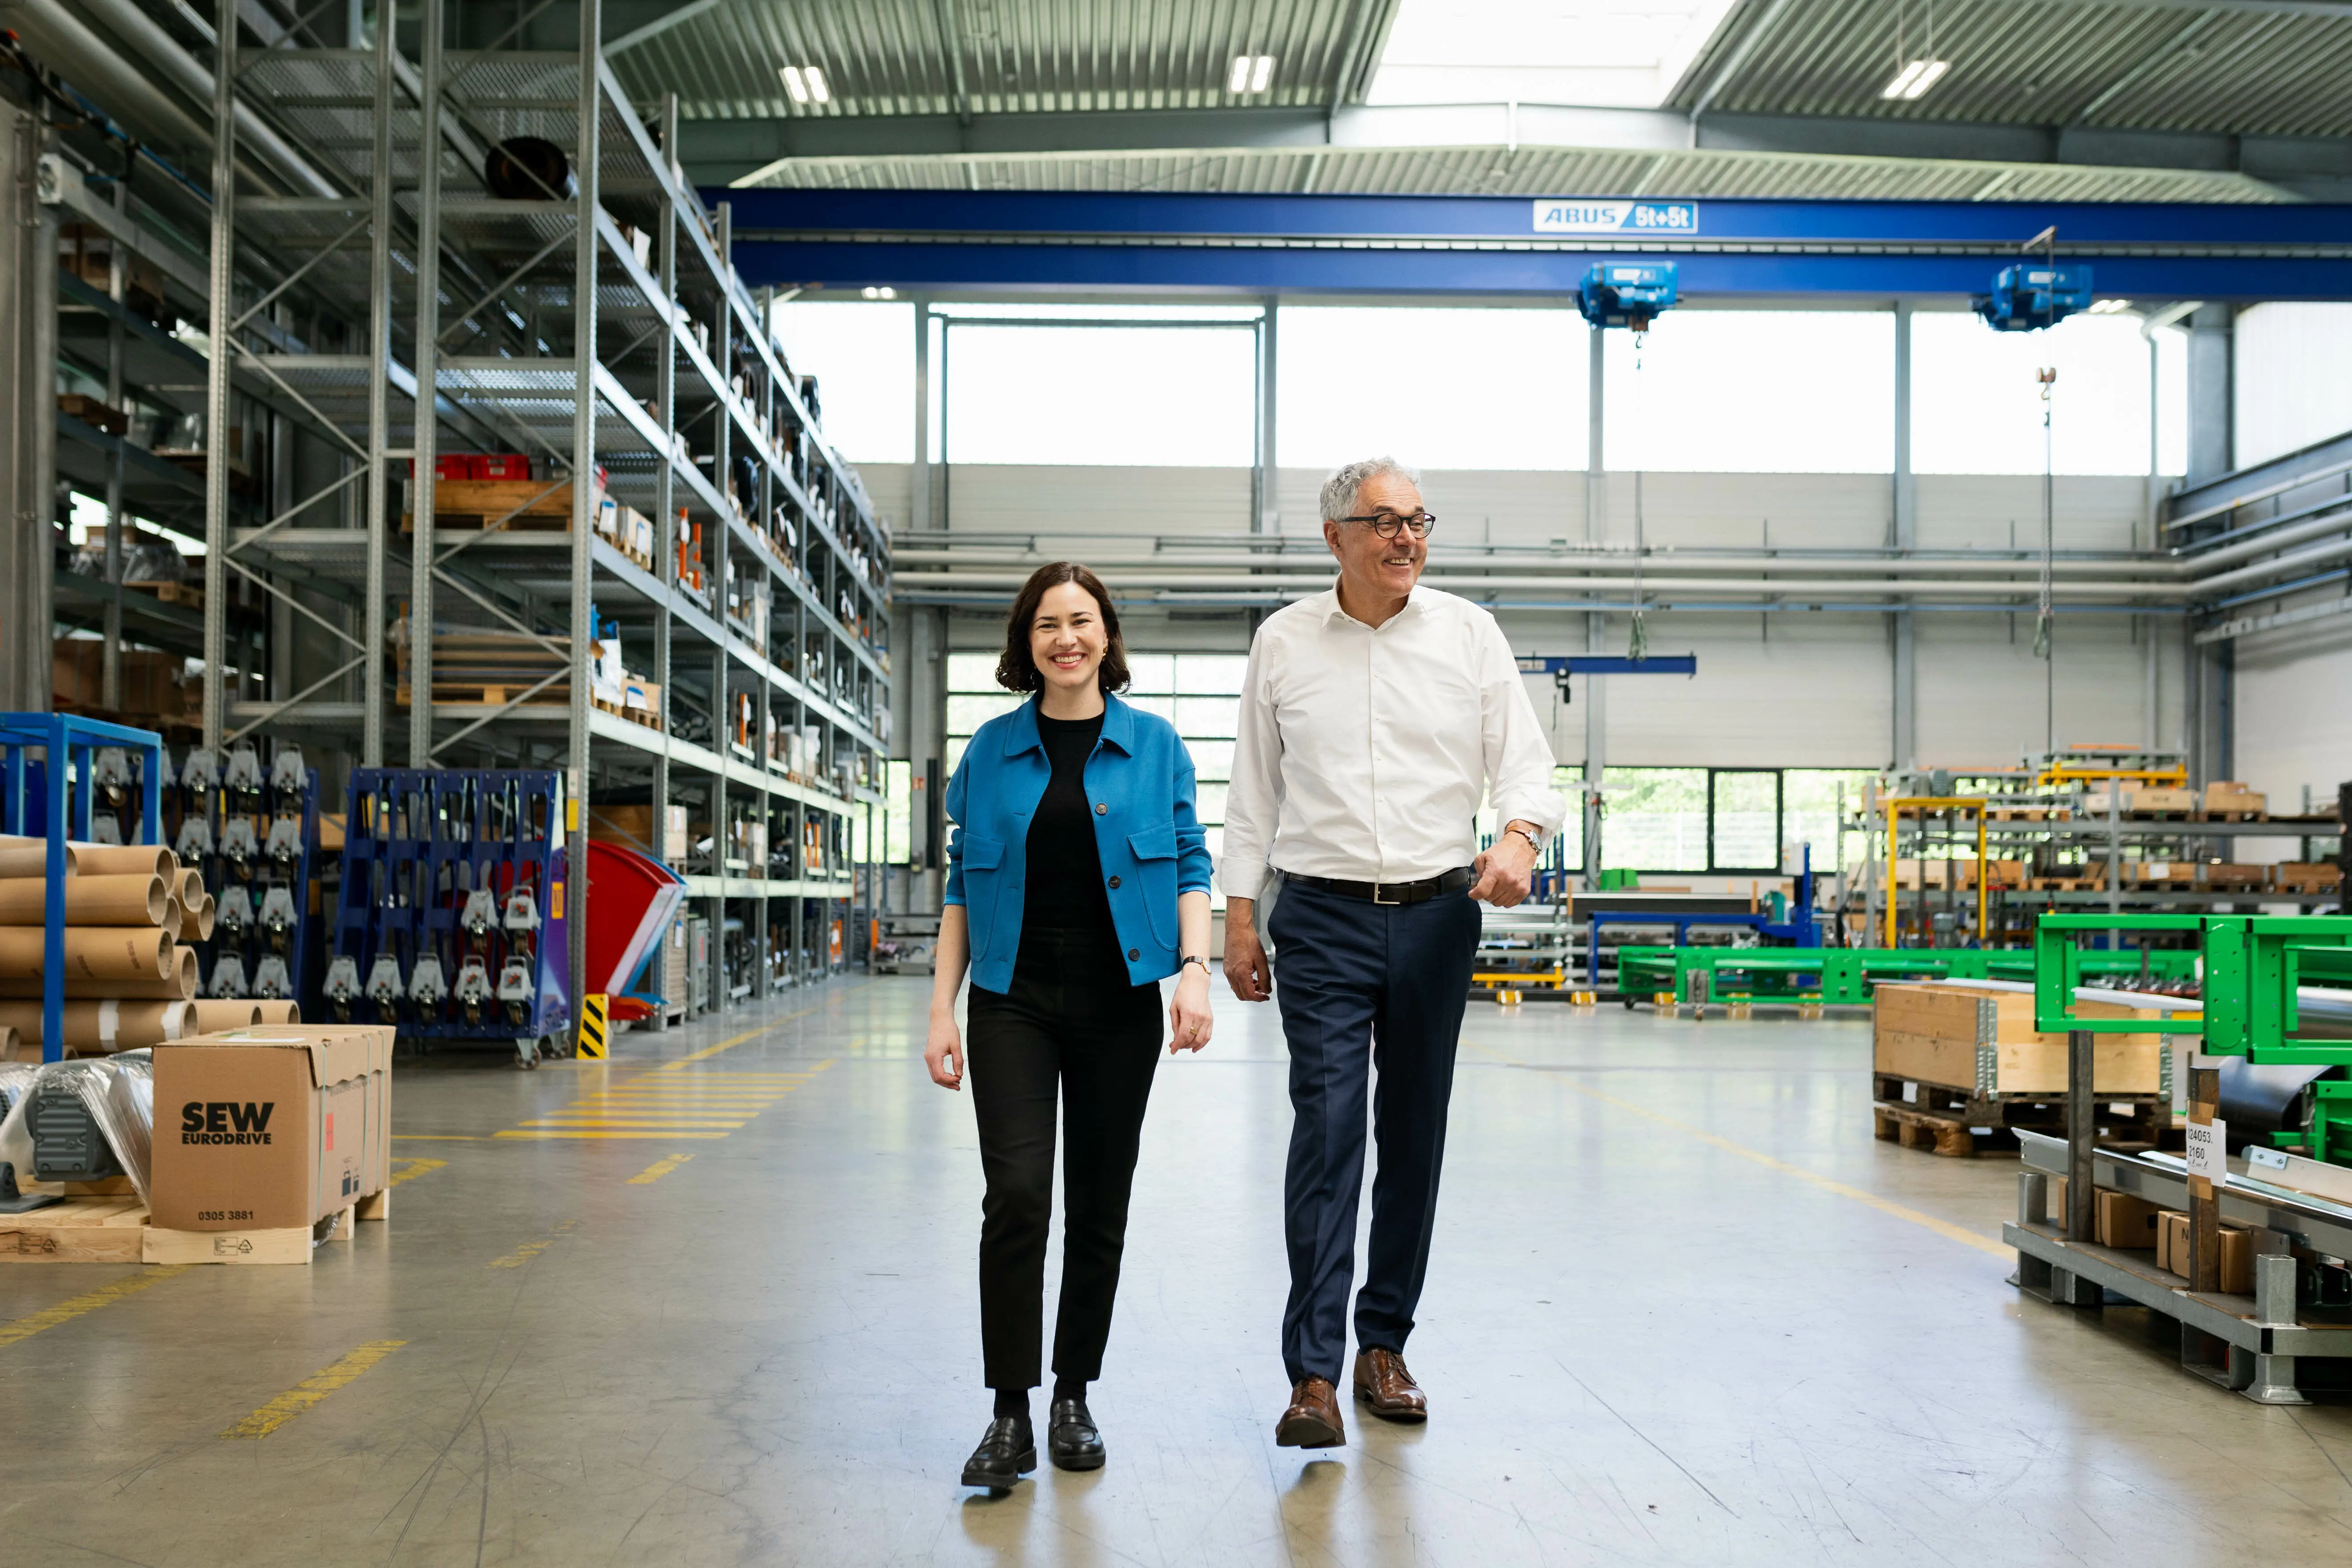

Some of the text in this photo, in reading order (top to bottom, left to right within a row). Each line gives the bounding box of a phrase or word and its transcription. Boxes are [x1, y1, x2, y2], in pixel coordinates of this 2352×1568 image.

[1544, 206, 1690, 227] ABUS 5t+5t
[181, 1101, 274, 1133] SEW
[182, 1133, 271, 1145] EURODRIVE
[2189, 1145, 2205, 1159] 2160
[198, 1210, 254, 1221] 0305 3881
